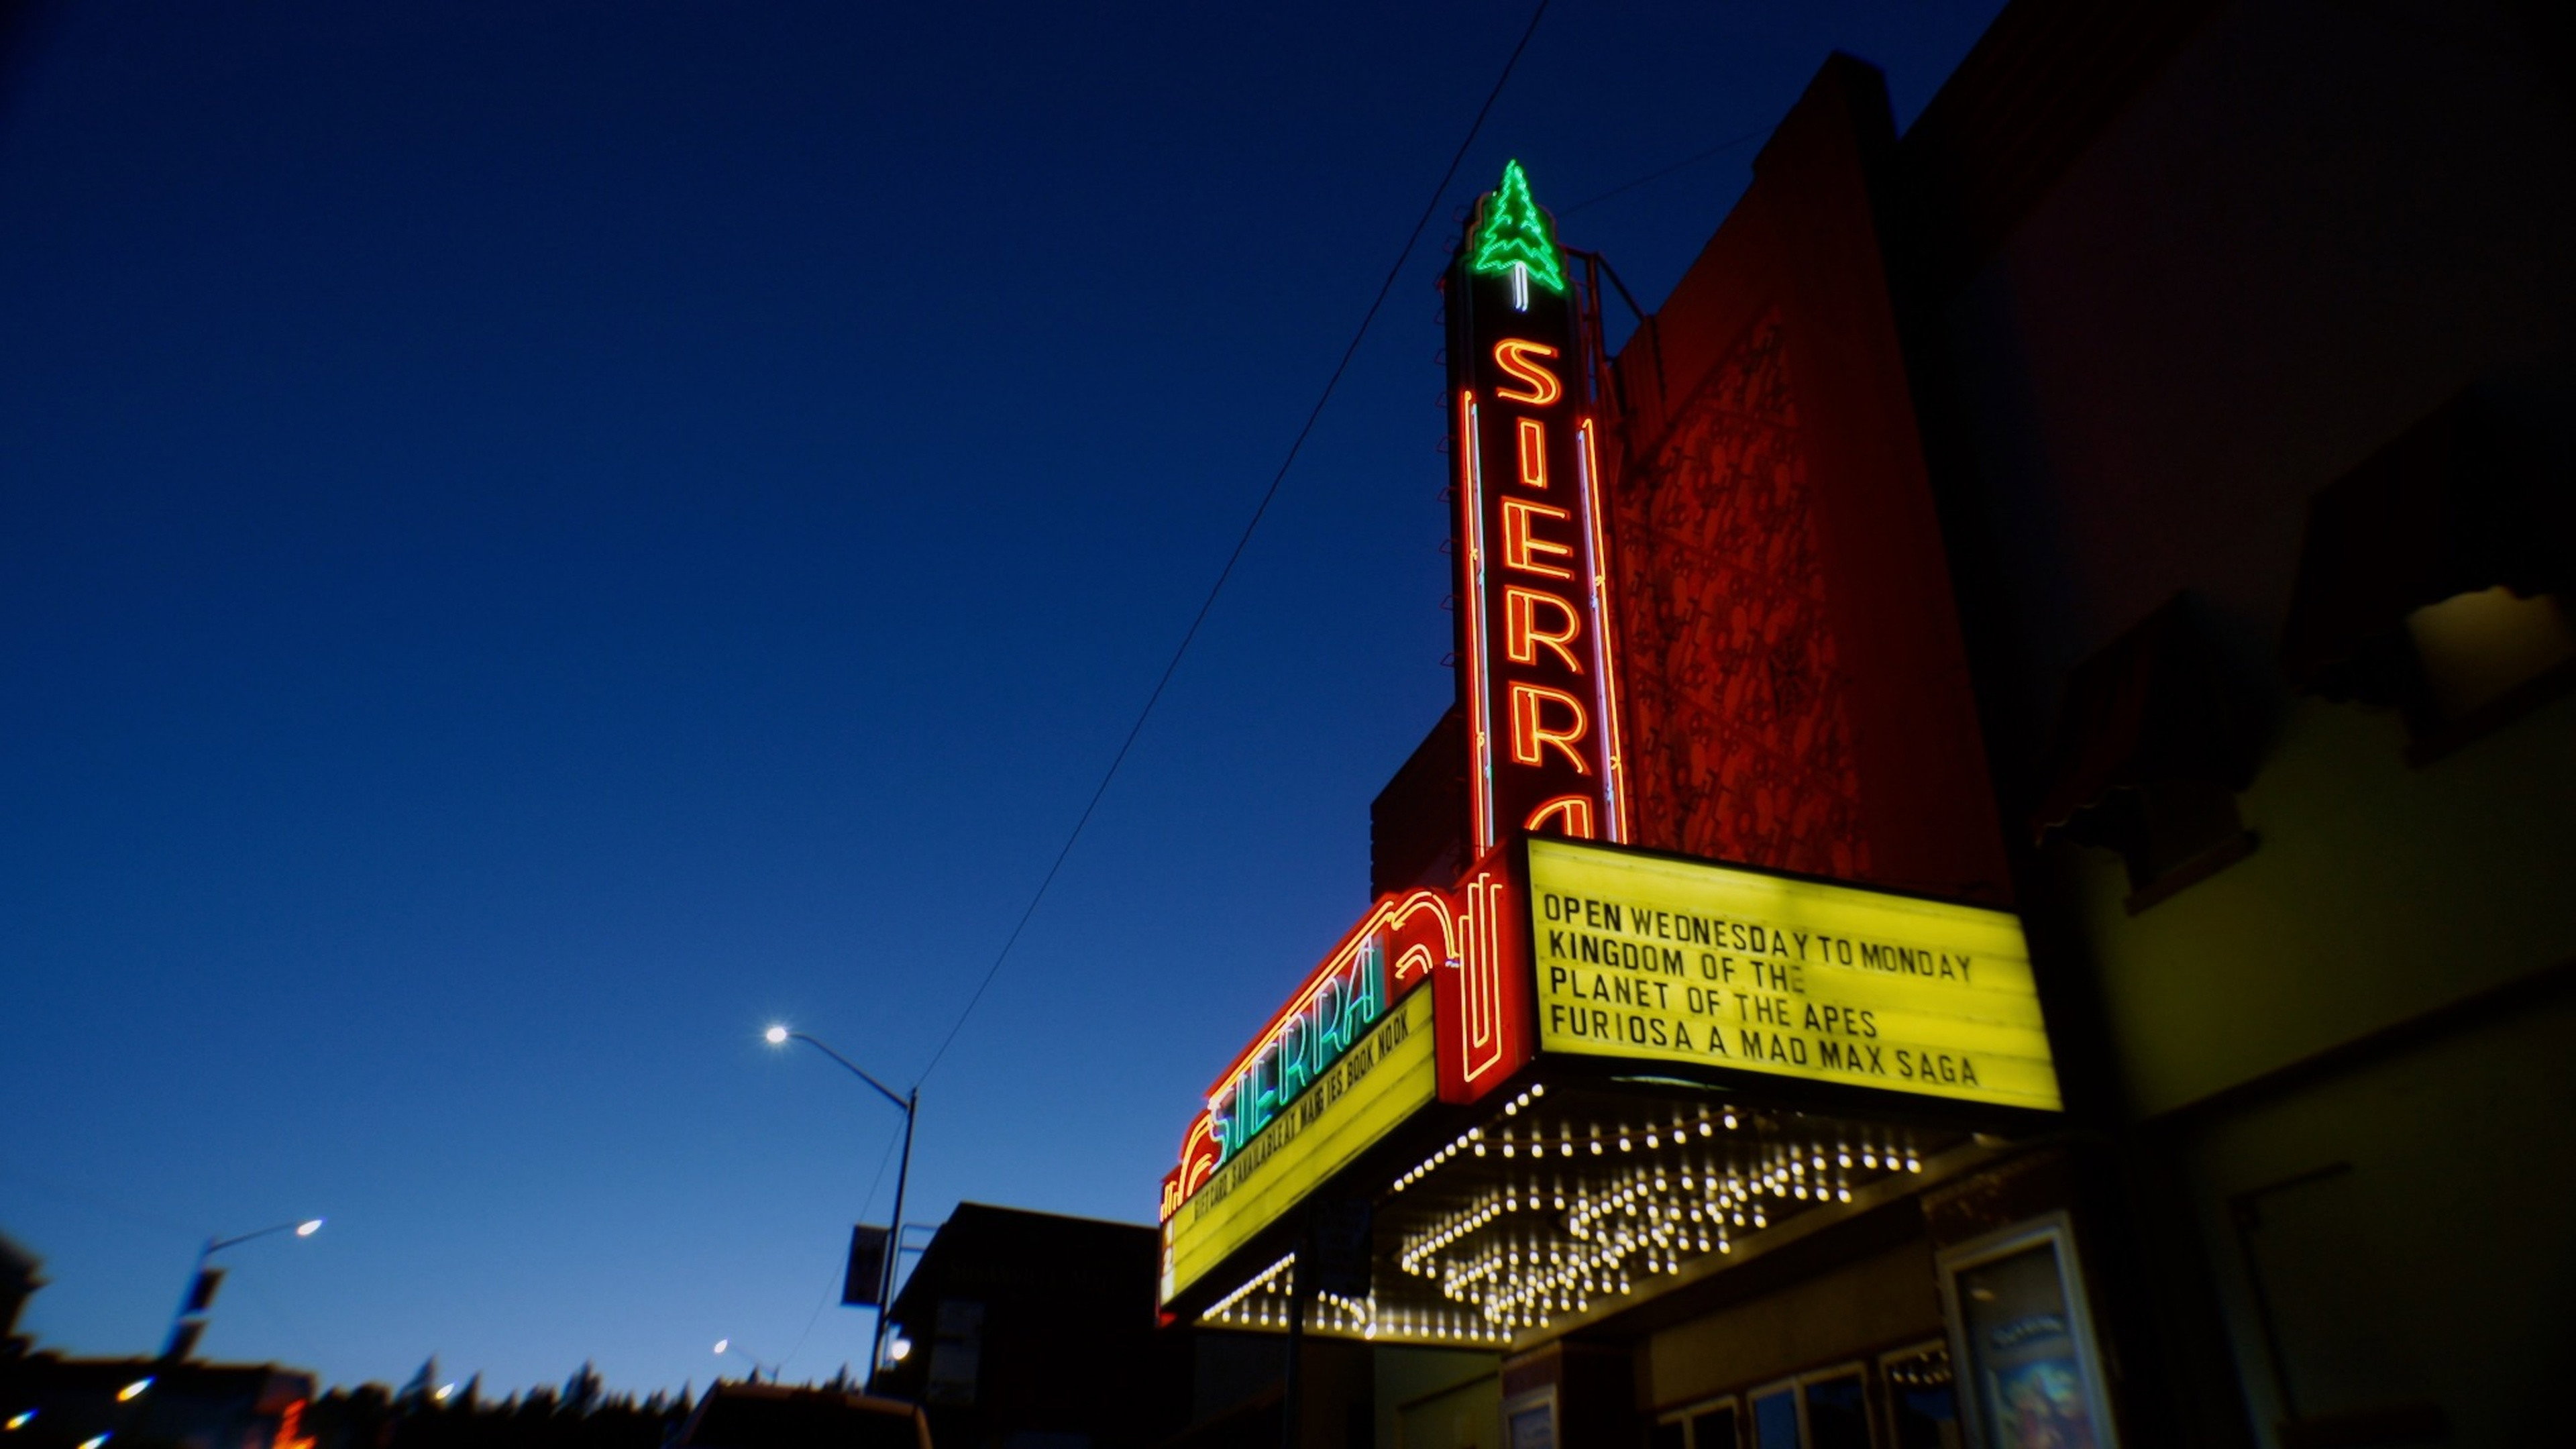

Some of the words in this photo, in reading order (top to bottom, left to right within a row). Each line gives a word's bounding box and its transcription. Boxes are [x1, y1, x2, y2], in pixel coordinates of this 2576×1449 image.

[1544, 894, 1621, 932] OPEN
[1631, 907, 1808, 960] WEDNESDAY
[1817, 936, 1852, 965] TO
[1860, 942, 1971, 982] MONDAY
[1550, 930, 1684, 977] KINGDOM
[1702, 953, 1735, 983] OF
[1750, 961, 1805, 994] THE
[1550, 966, 1668, 1009] PLANET
[1688, 986, 1720, 1016] OF
[1735, 994, 1790, 1027] THE
[1805, 1004, 1877, 1038] APES
[1208, 934, 1383, 1174] SIERRA
[1347, 1041, 1373, 1087] BOOK
[1379, 1009, 1409, 1061] NOOK
[1550, 1004, 1693, 1050] FURIOSA
[1709, 1026, 1727, 1055] A
[1741, 1029, 1807, 1065] MAD
[1819, 1040, 1885, 1075] MAX
[1896, 1050, 1978, 1087] SAGA
